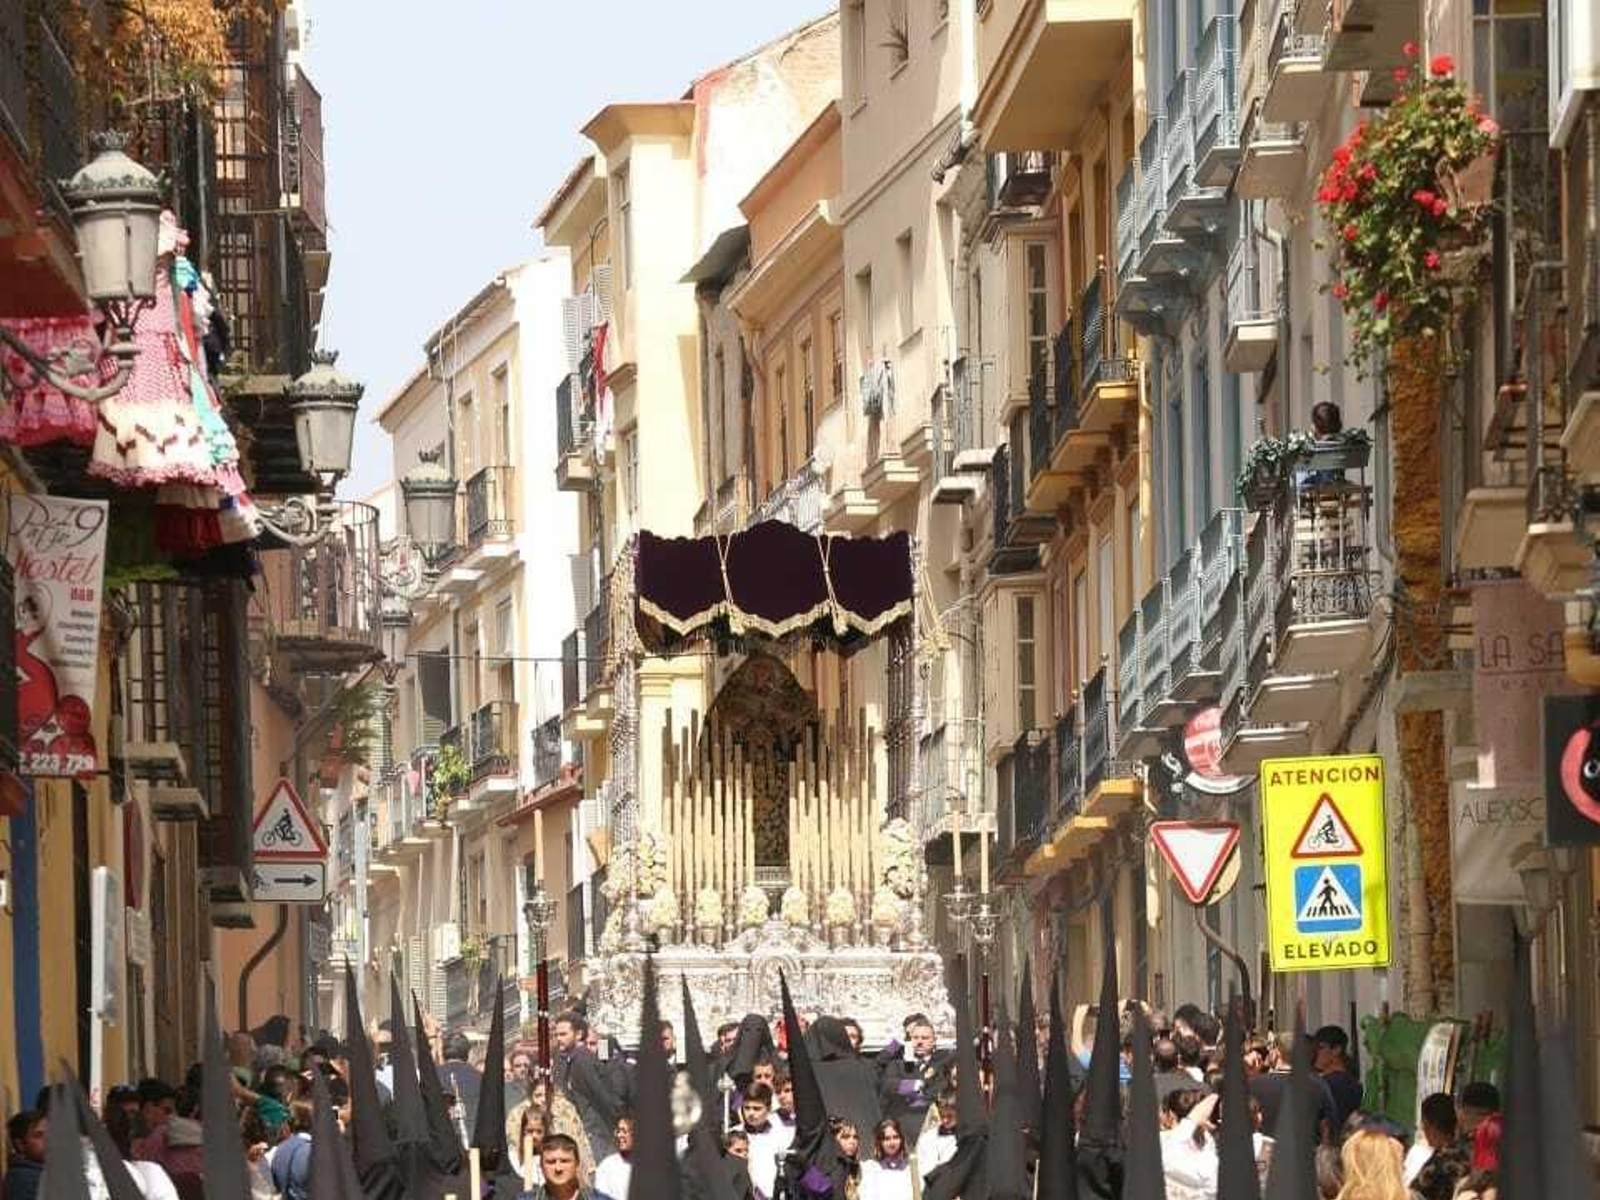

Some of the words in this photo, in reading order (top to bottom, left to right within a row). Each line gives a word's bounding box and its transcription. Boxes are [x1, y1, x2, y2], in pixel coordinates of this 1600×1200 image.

[1479, 635, 1511, 668] LA
[1270, 766, 1379, 787] ATENCION
[1284, 940, 1378, 959] ELEVADO
